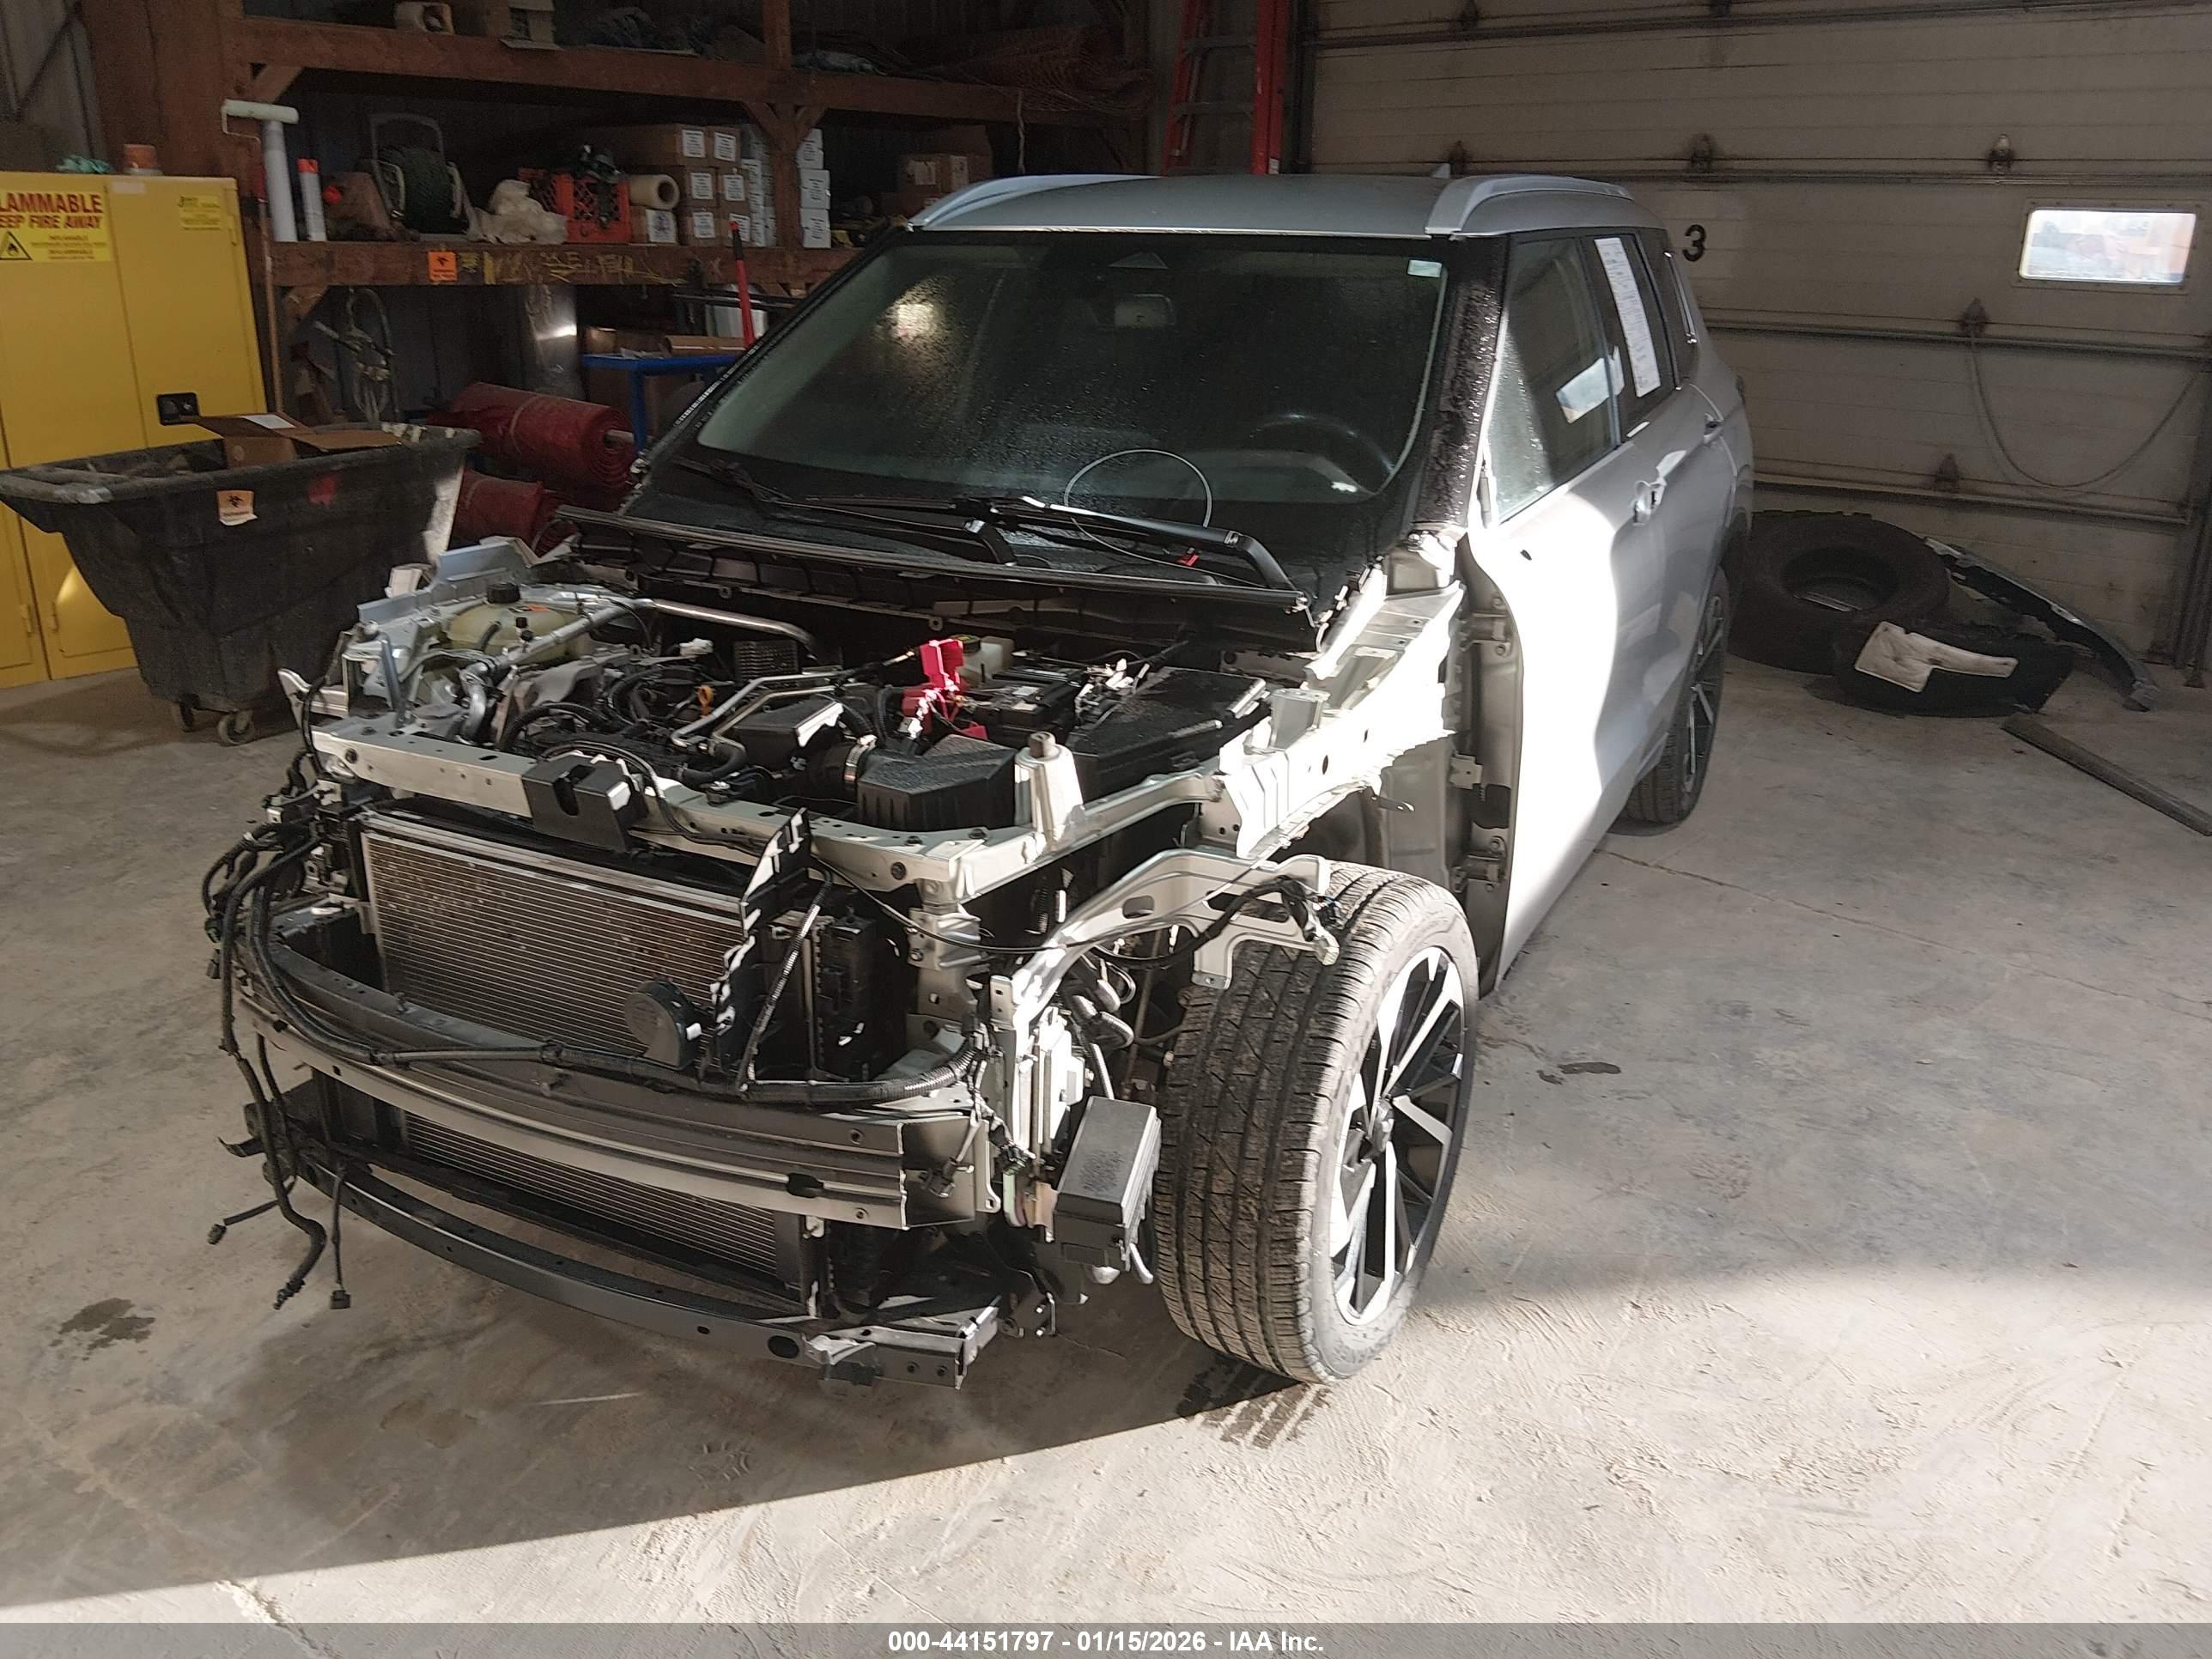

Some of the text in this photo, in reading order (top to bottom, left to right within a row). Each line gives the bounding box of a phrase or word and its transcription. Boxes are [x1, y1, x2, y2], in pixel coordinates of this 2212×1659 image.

[29, 215, 60, 228] FIRE
[64, 215, 102, 229] AWAY
[1682, 224, 1707, 262] 3
